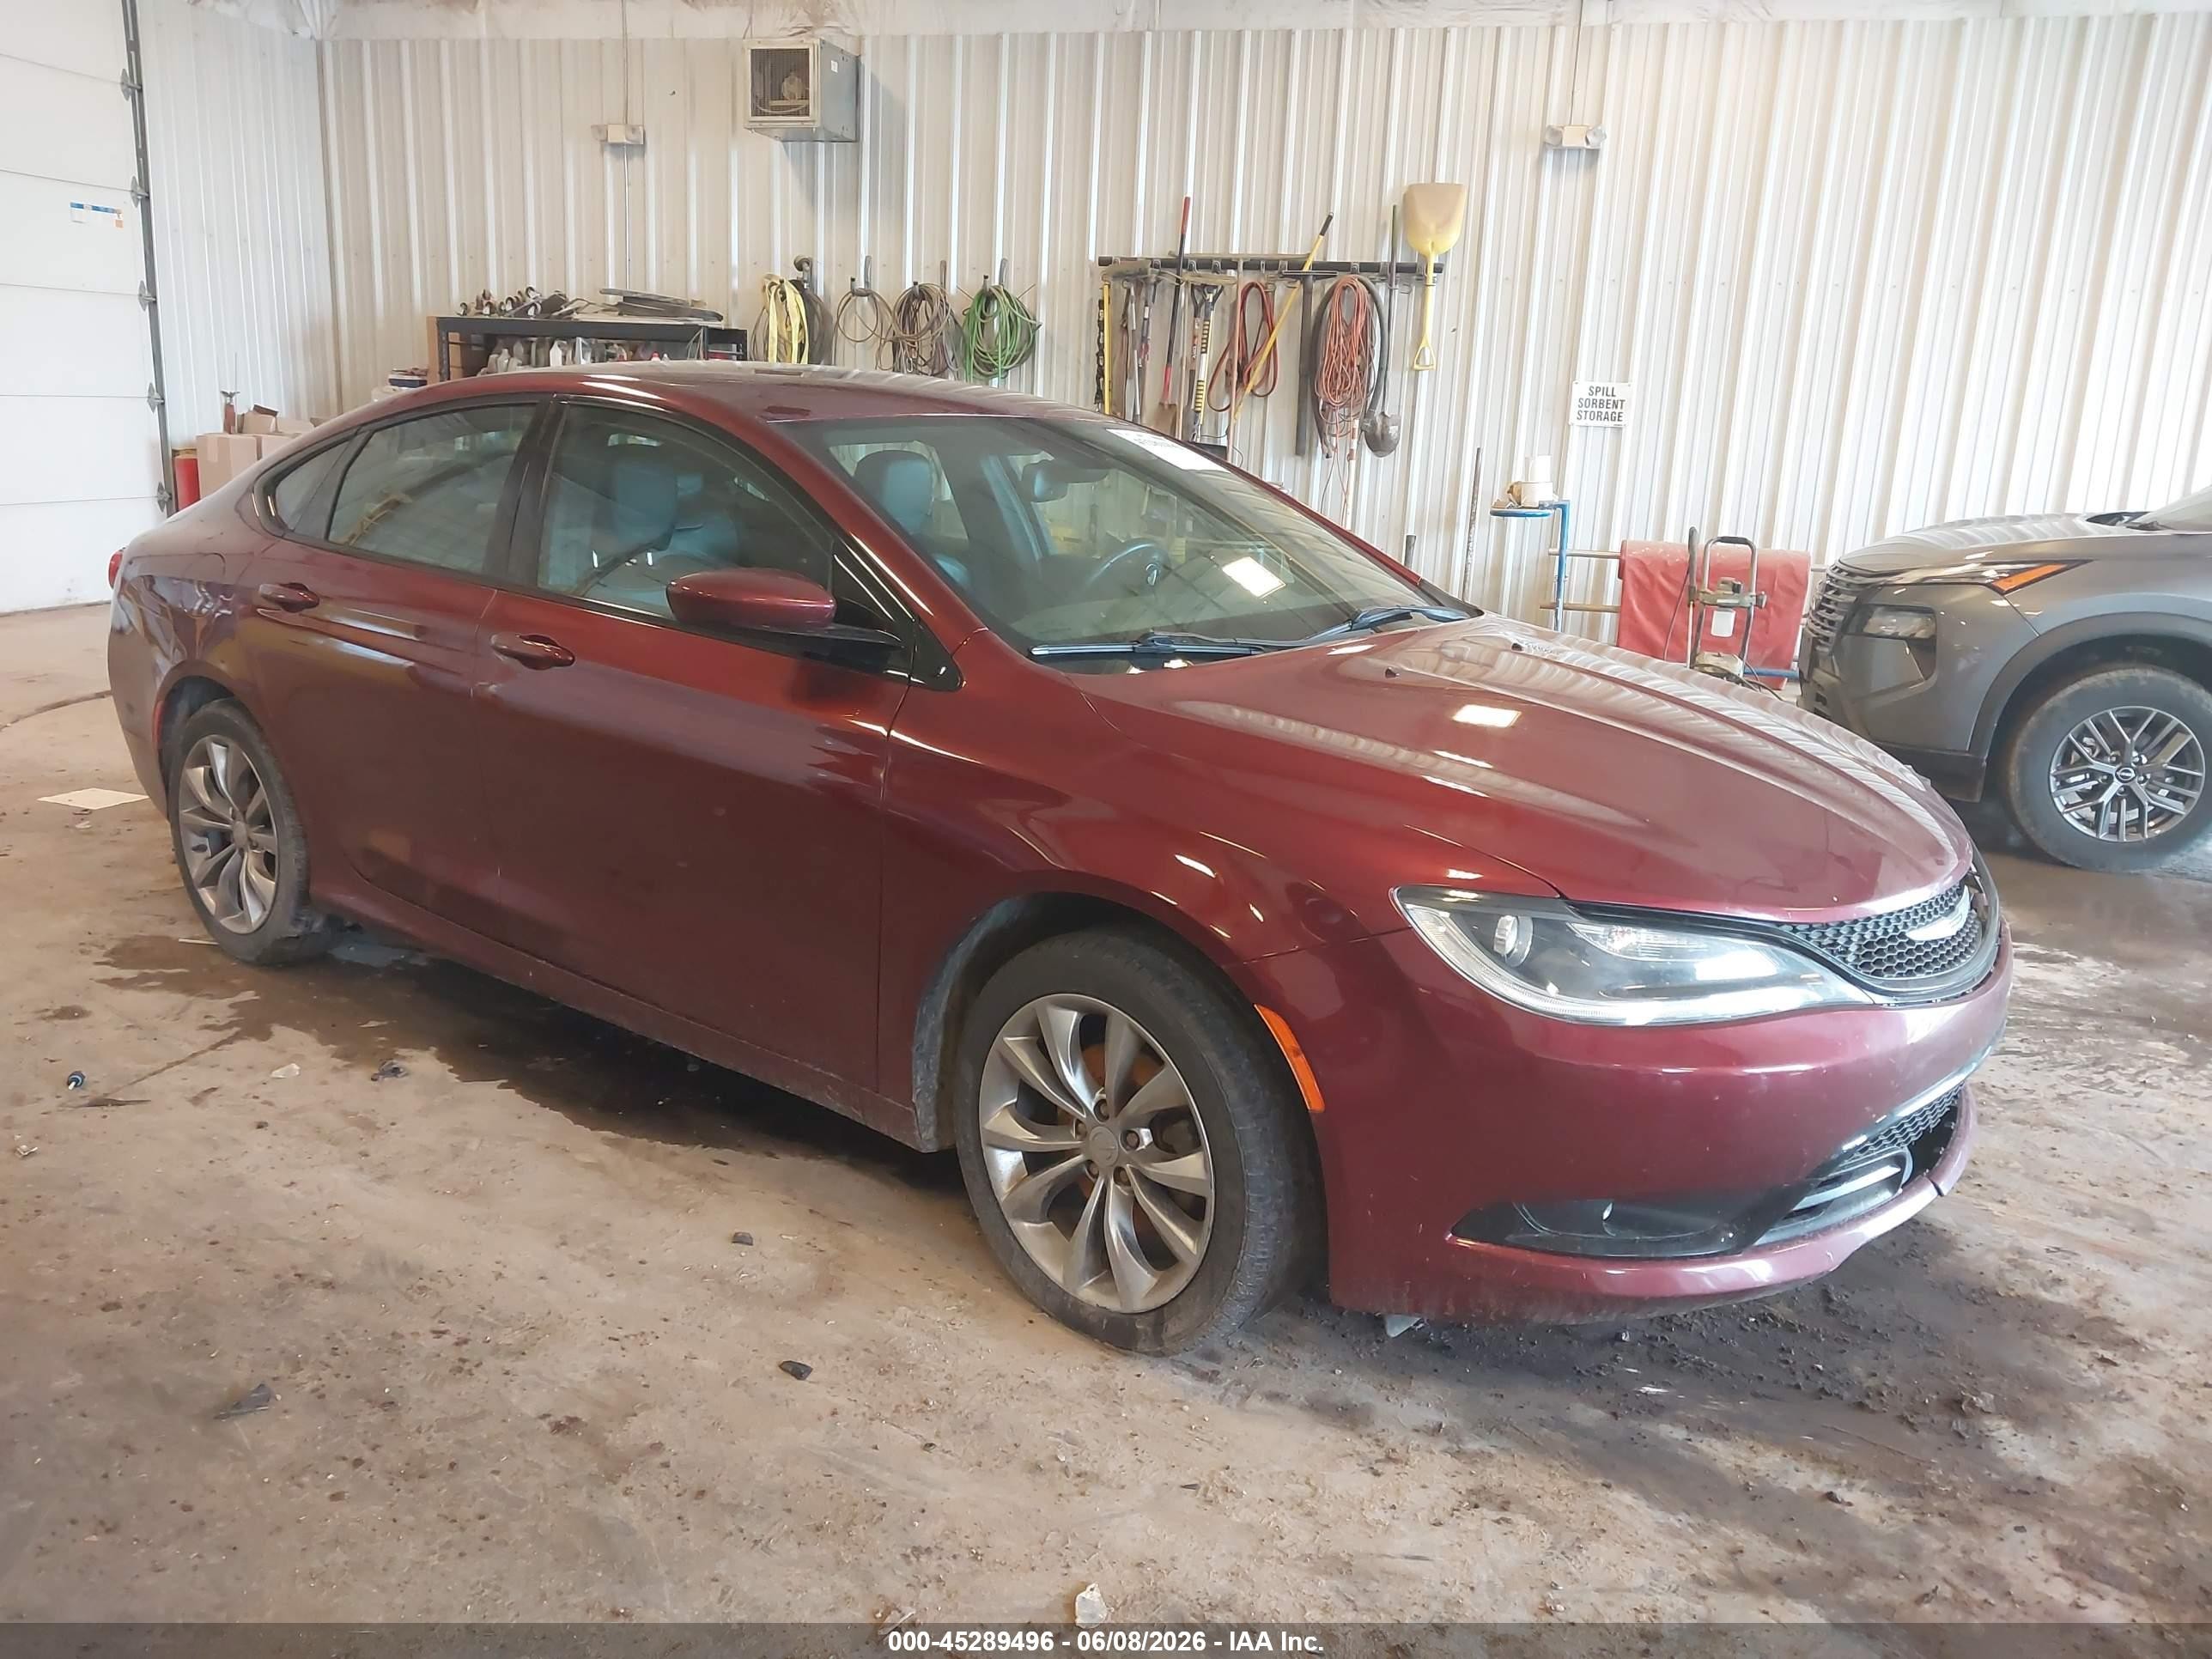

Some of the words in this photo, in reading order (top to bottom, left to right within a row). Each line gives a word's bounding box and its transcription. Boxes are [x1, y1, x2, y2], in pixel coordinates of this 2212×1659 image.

[1588, 386, 1616, 397] SPILL
[1577, 398, 1626, 410] SORBENT
[1577, 410, 1623, 422] STORAGE
